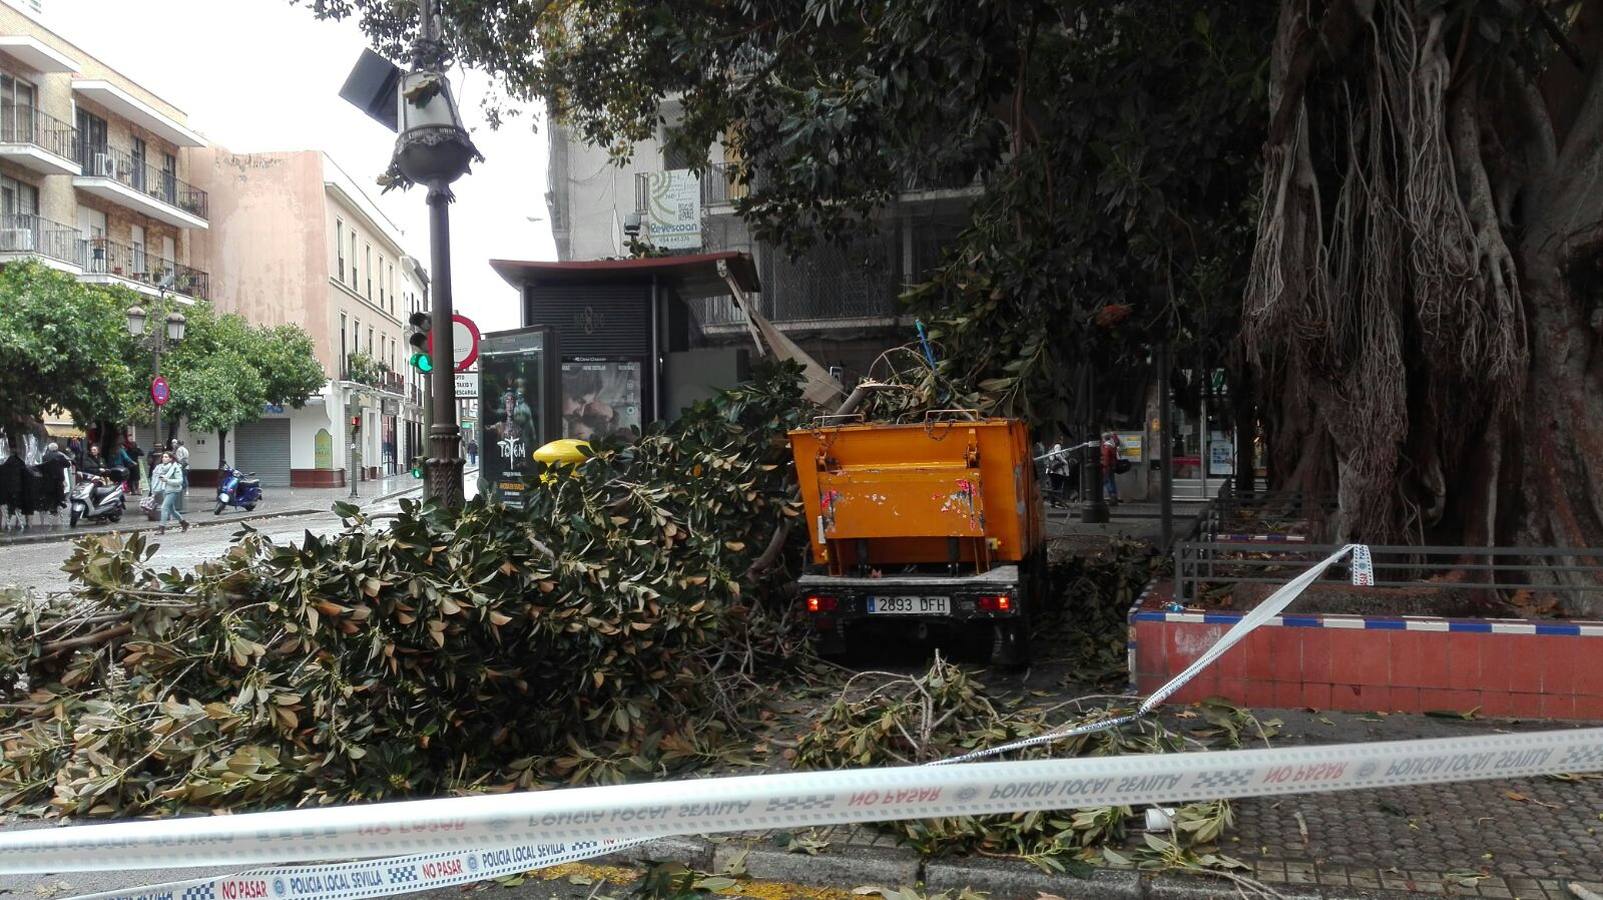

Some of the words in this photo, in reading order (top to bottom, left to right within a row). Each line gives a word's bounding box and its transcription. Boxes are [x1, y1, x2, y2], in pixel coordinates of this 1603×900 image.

[497, 436, 526, 470] TOTEM
[880, 598, 913, 611] 2893
[920, 598, 946, 611] DFH
[482, 849, 512, 868] POLICIA
[512, 845, 537, 863] LOCAL
[537, 842, 566, 859] SEVILLA
[422, 863, 437, 879] NO
[437, 859, 463, 876] PASAR
[222, 881, 237, 899] NO
[239, 880, 269, 899] PASAR
[290, 877, 323, 894] POLICIA
[323, 873, 351, 891] LOCAL
[351, 870, 384, 888] SEVILLA
